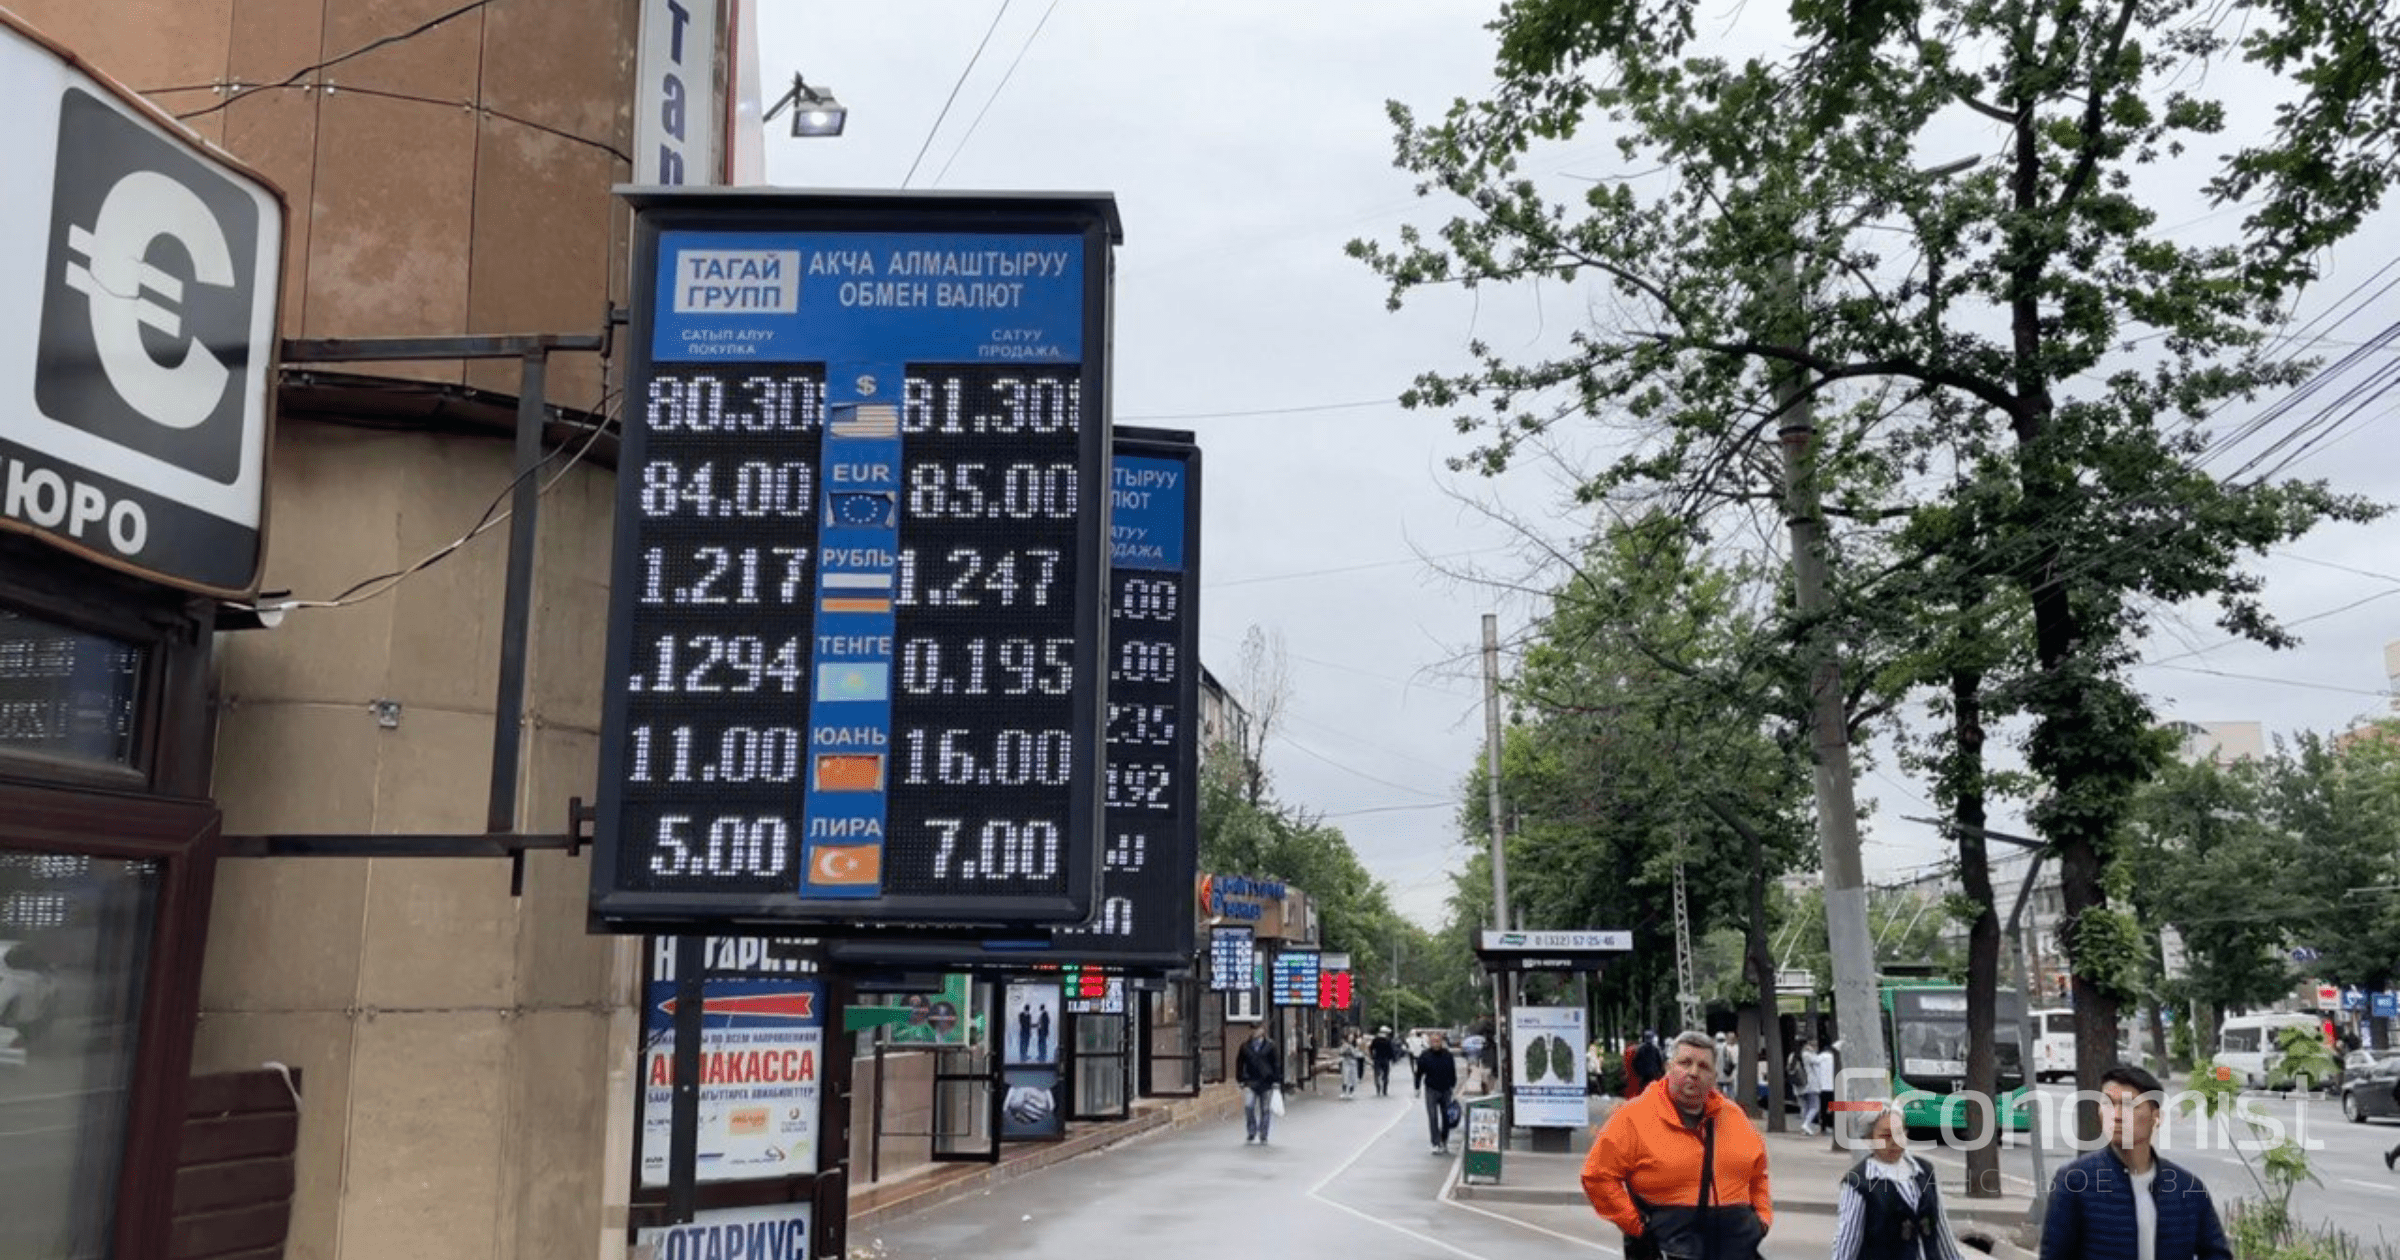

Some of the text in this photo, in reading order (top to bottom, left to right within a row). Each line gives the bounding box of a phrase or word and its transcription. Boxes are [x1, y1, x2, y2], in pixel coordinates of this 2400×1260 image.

[688, 252, 781, 281] ТАГАЙ
[808, 250, 1069, 278] АКЧА АЛМАШТЫРУУ
[687, 286, 781, 309] ГРУПП
[839, 282, 1025, 309] ОБМЕН ВАЛЮТ
[681, 329, 775, 342] САТЫП АЛУУ
[687, 343, 756, 355] ПОКУПКА
[991, 329, 1043, 342] САТУУ
[977, 344, 1061, 359] ПРОДАЖА
[856, 376, 876, 397] $
[833, 464, 890, 482] EUR
[641, 461, 812, 517] 84.00
[910, 463, 1078, 519] 85.00
[0, 456, 148, 556] ЮРО
[822, 548, 896, 569] РУБЛЬ
[641, 547, 809, 603] 1.217
[895, 549, 1060, 606] 1.247
[818, 636, 893, 656] ТЕНГЕ
[903, 638, 1075, 695] 0.195
[813, 726, 887, 746] ЮАНЬ
[628, 726, 799, 783] 11.00
[905, 728, 1072, 786] 16.00
[809, 817, 882, 838] ЛИРА
[650, 815, 789, 877] 5.00
[924, 819, 1059, 880] 7.00
[649, 1049, 815, 1087] ААКАССА
